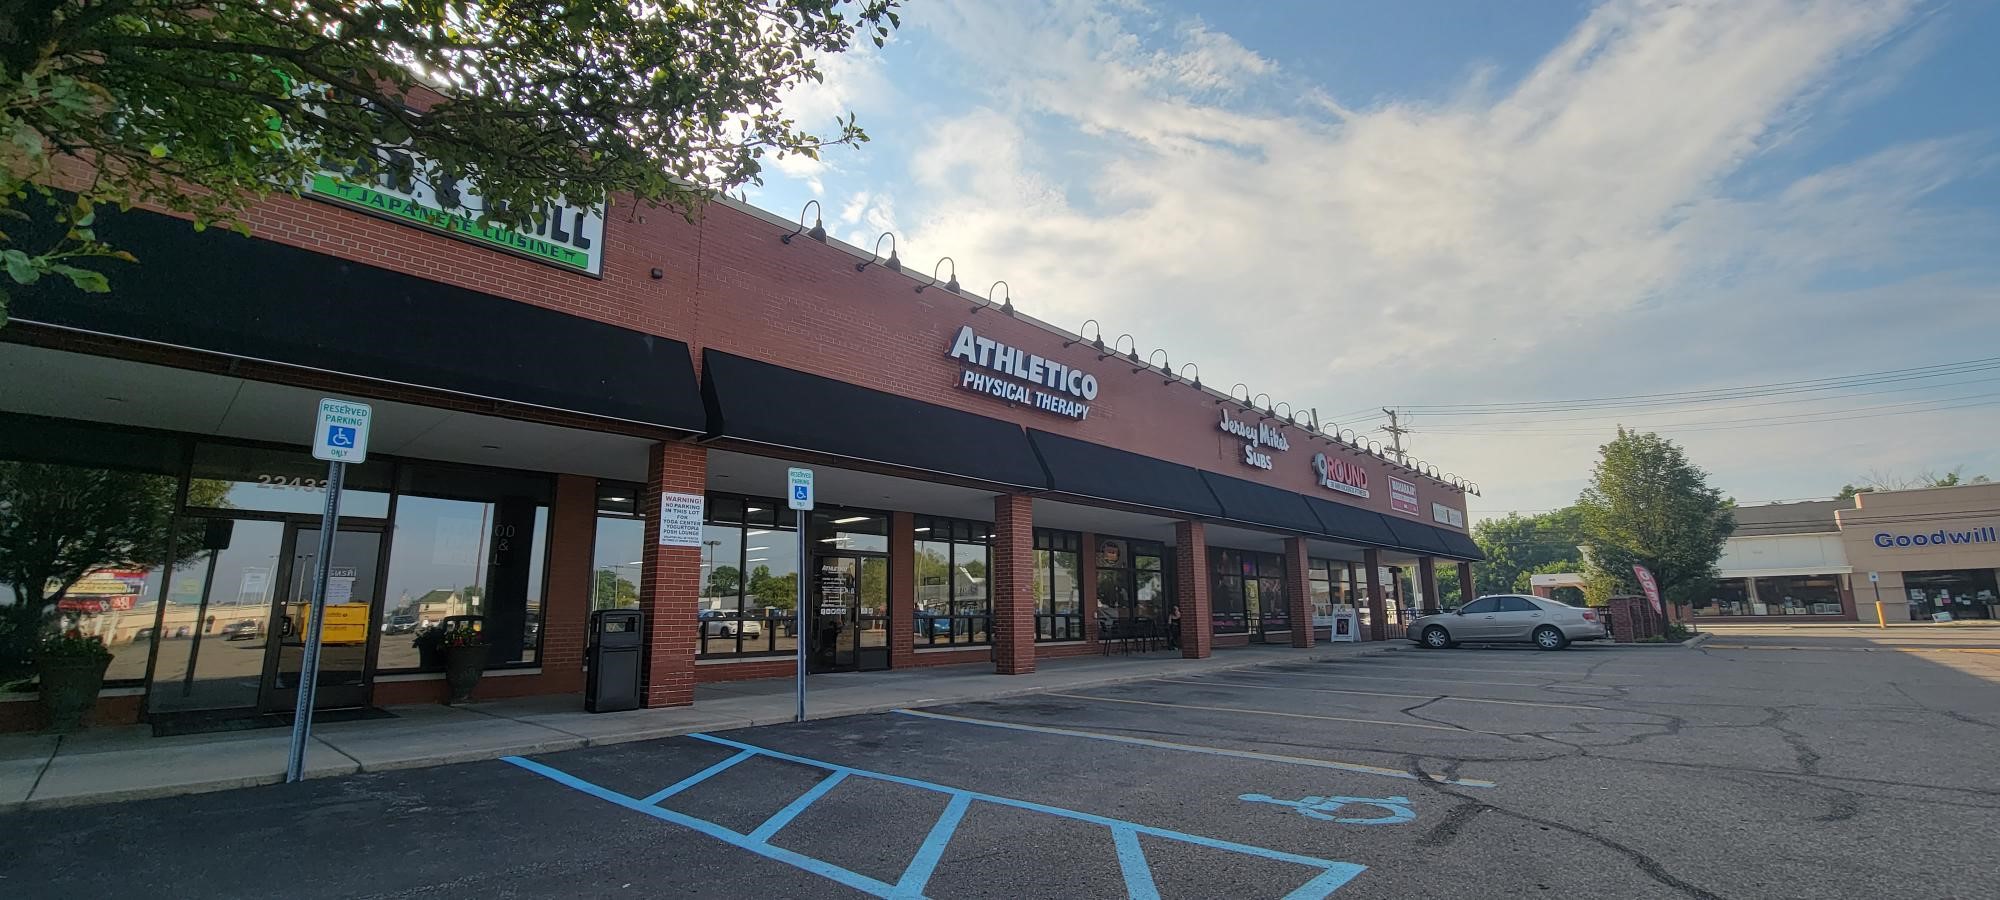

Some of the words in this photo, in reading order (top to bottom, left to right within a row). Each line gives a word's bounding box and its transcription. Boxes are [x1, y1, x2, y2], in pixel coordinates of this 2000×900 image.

[483, 226, 560, 258] CUISINE
[950, 325, 1098, 401] ATHLETICO
[962, 371, 1032, 405] PHYSICAL
[1035, 390, 1090, 421] THERAPY
[323, 403, 368, 417] RESERVED
[325, 414, 363, 426] PARKING
[1220, 408, 1258, 447] Jersey
[331, 449, 349, 458] ONLY
[666, 496, 702, 504] WARNING!
[1874, 527, 1997, 548] Goodwill
